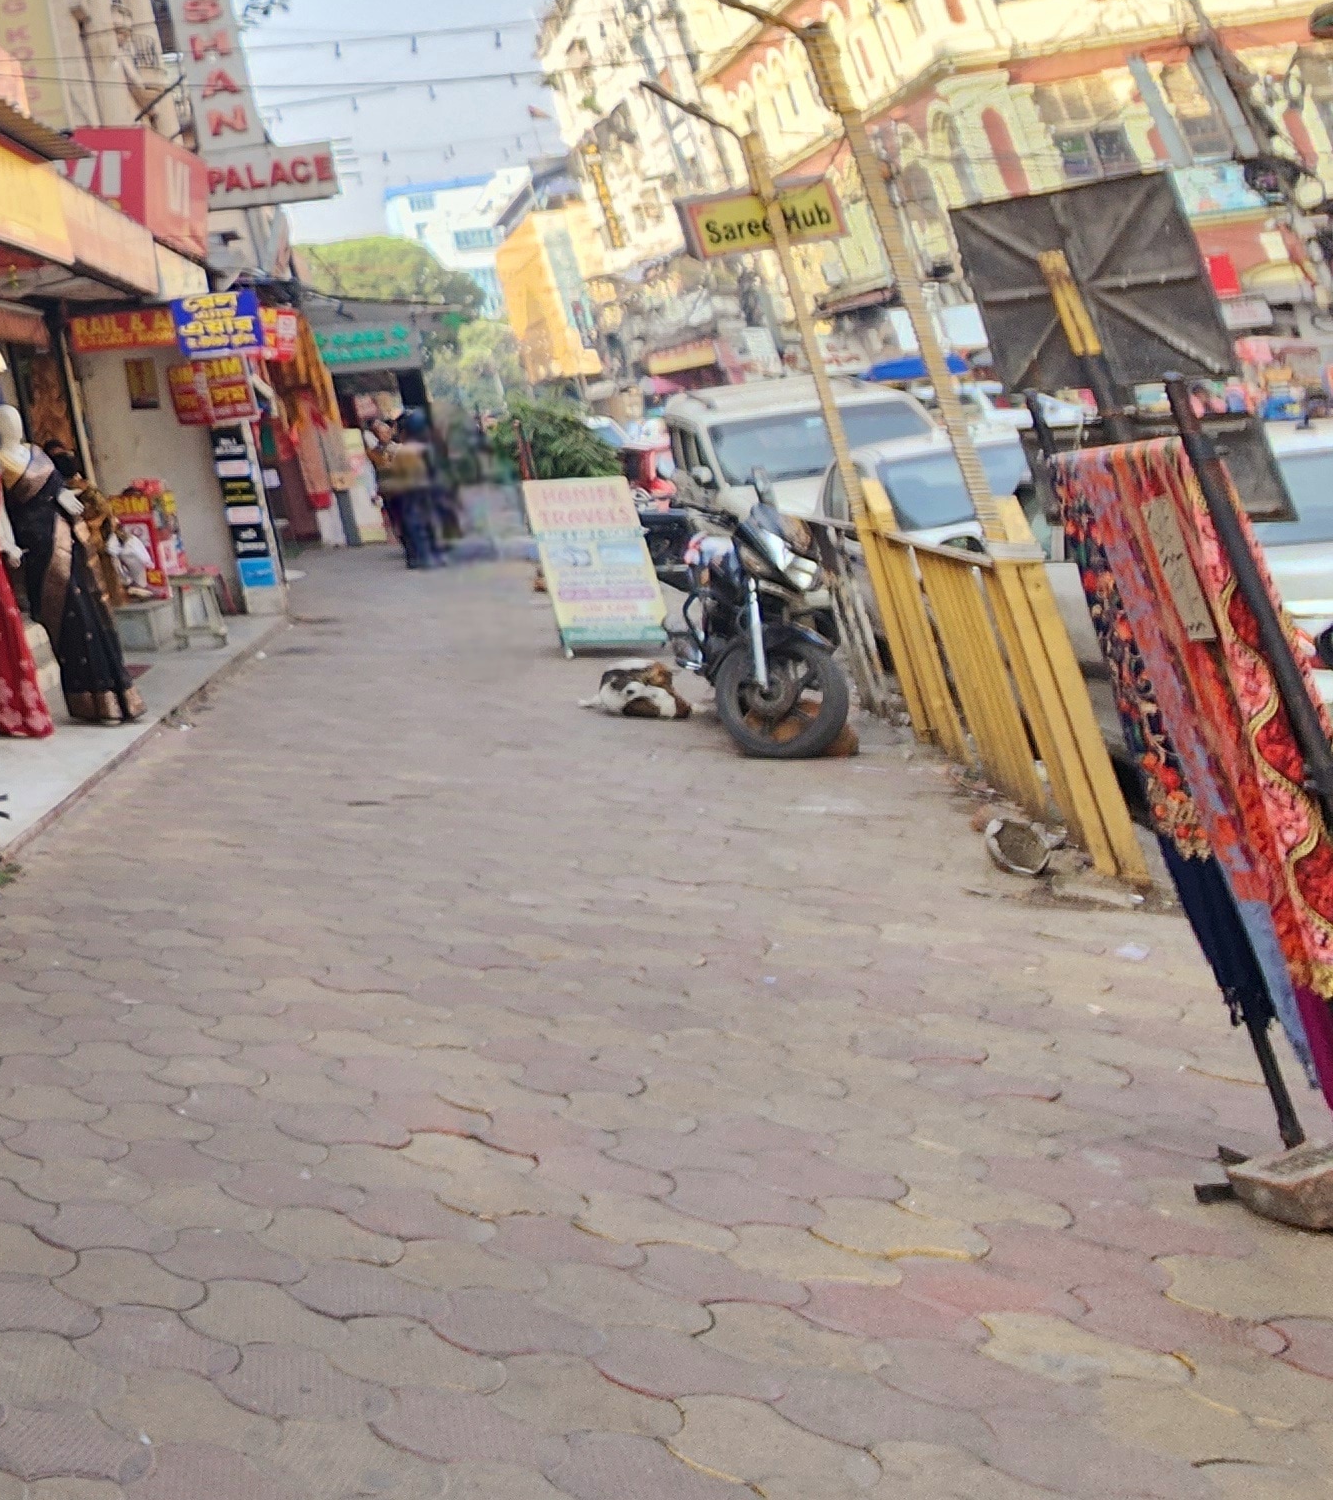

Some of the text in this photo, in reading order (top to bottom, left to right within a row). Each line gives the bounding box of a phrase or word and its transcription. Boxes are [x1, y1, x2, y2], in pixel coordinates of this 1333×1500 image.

[206, 154, 334, 197] PALACE
[780, 202, 832, 235] Hub
[72, 314, 124, 336] RAIL
